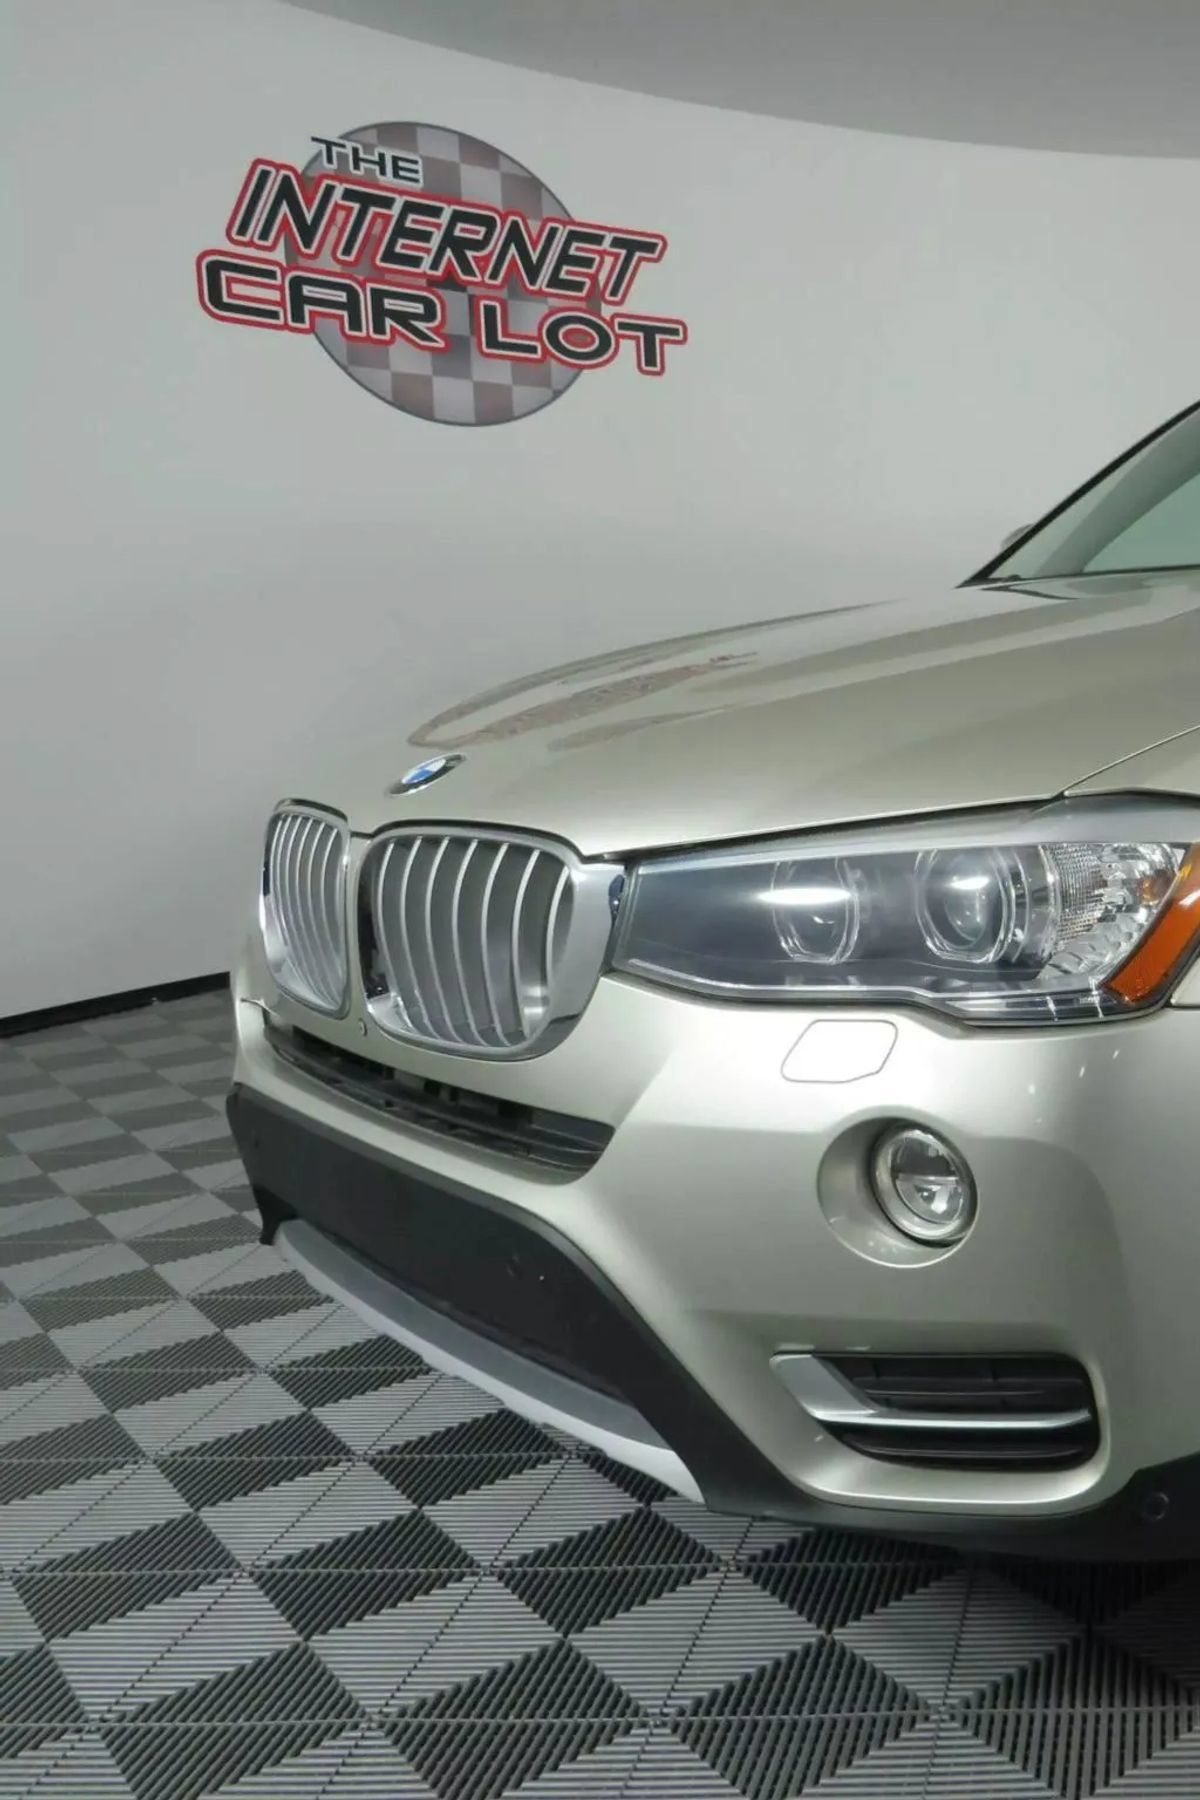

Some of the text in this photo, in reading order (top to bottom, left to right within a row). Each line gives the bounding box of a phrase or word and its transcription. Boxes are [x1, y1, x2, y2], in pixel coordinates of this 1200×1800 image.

[310, 136, 422, 183] THE
[229, 161, 665, 303] INTERNET
[199, 252, 687, 374] CAR LOT
